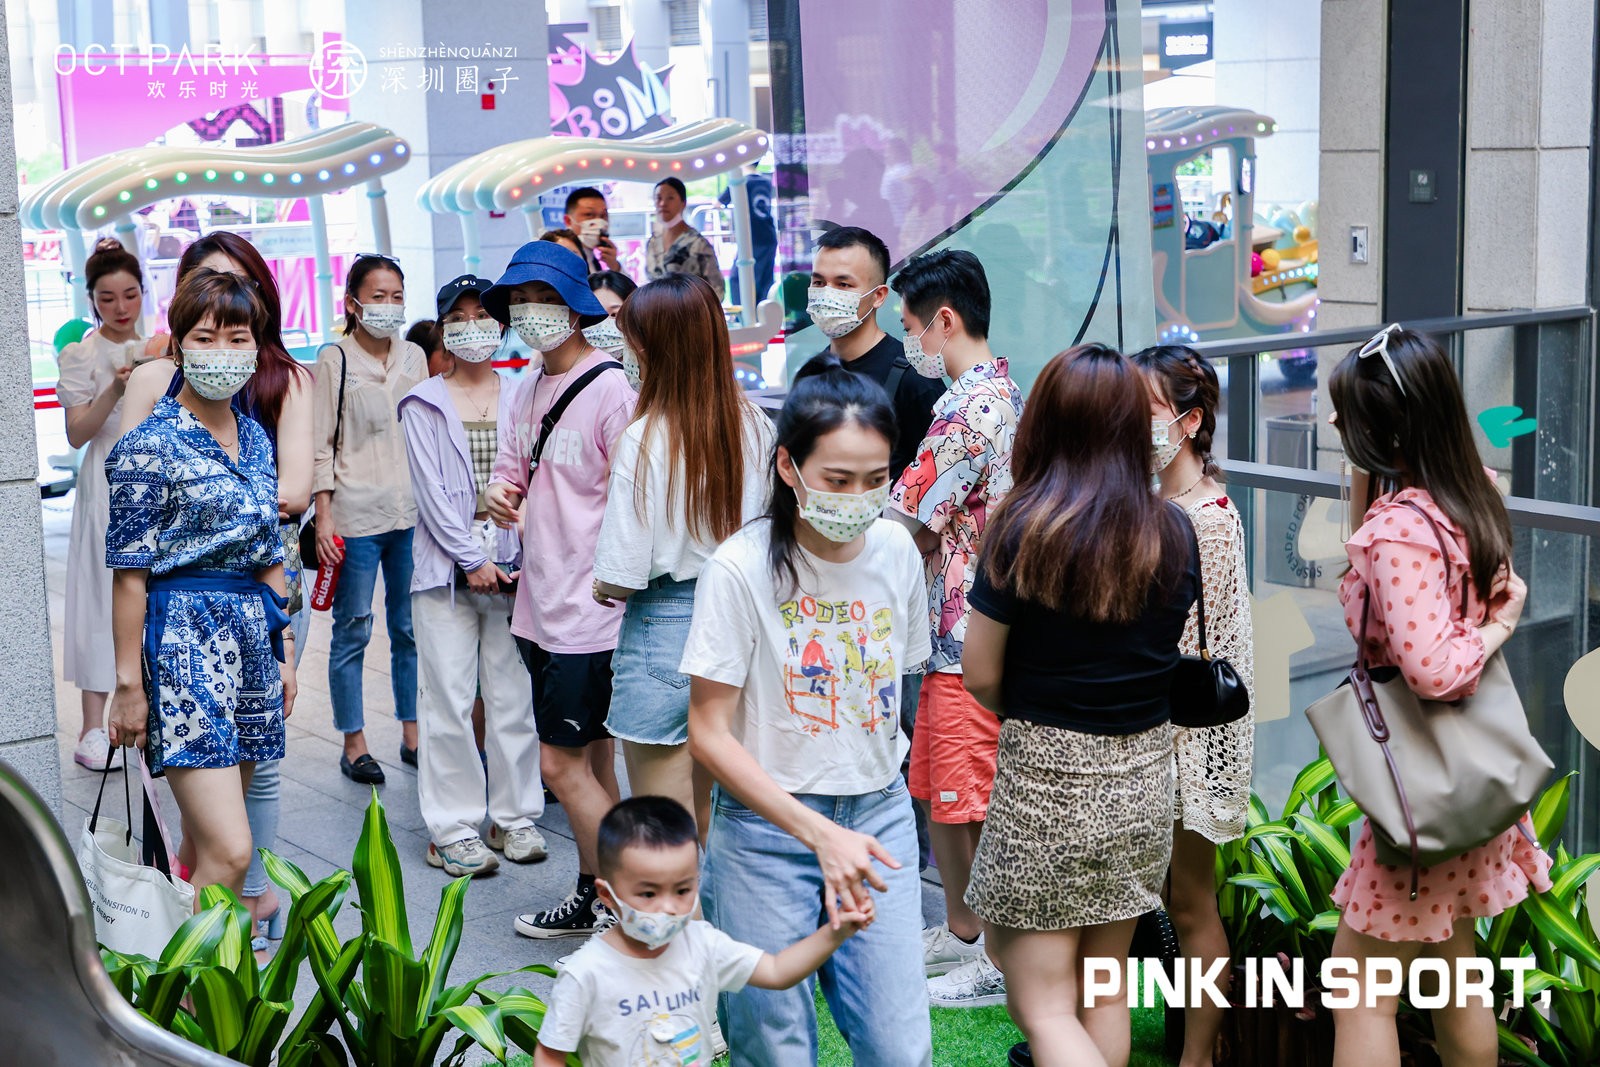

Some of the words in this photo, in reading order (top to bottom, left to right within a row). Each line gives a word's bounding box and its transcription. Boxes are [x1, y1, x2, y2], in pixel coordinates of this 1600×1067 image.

[315, 561, 335, 606] preme
[778, 596, 866, 629] RODEO
[140, 909, 150, 919] TO
